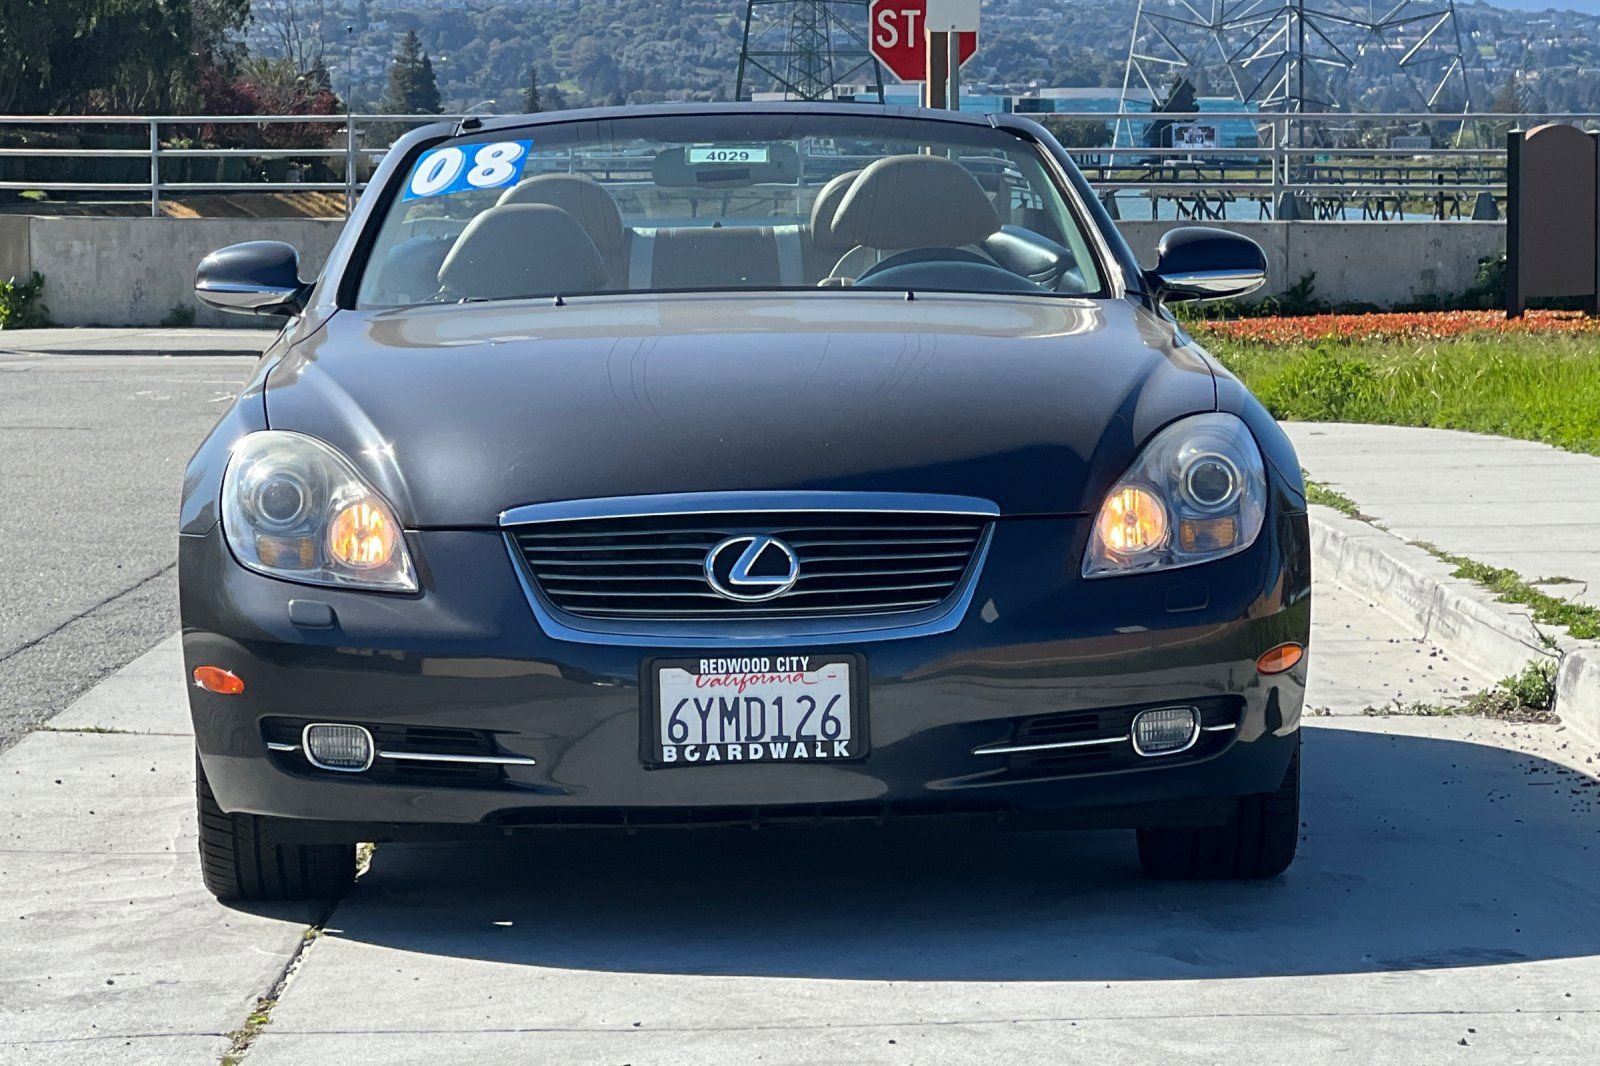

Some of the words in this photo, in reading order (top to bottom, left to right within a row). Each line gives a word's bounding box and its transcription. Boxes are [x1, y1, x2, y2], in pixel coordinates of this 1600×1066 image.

[876, 9, 928, 48] ST
[706, 151, 749, 161] 4029
[411, 142, 525, 196] 08
[700, 658, 769, 674] REDWOOD
[776, 656, 809, 672] CITY
[695, 672, 818, 694] California
[667, 694, 842, 744] 6YMD126
[662, 741, 850, 763] BOARDWALK
